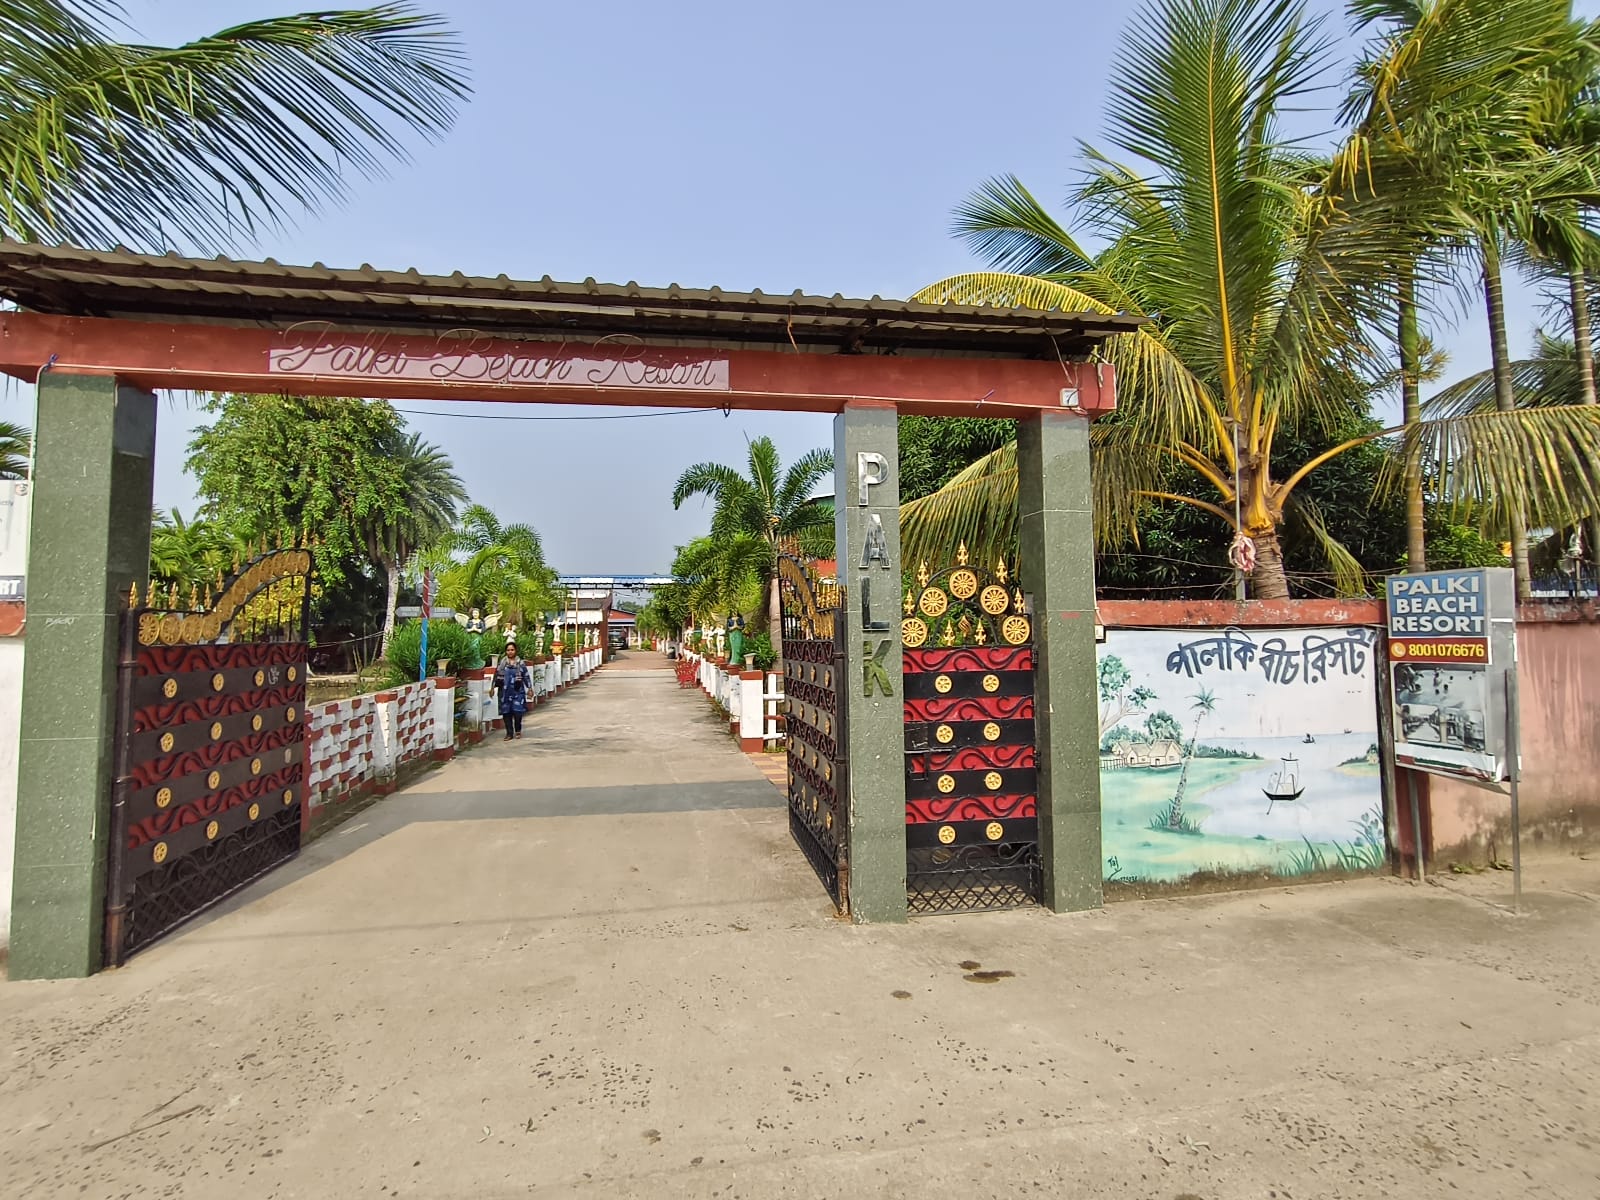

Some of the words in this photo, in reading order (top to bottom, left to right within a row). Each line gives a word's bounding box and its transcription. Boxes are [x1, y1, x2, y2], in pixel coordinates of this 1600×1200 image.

[269, 321, 408, 374] Palki
[430, 328, 573, 380] Beach
[587, 333, 716, 386] Resort
[1392, 577, 1479, 596] PALKI
[1396, 597, 1477, 614] BEACH
[1392, 616, 1484, 633] RESORT
[1166, 627, 1258, 679] পালকি
[1259, 638, 1300, 684] বীচ
[1408, 643, 1484, 657] 8001076676
